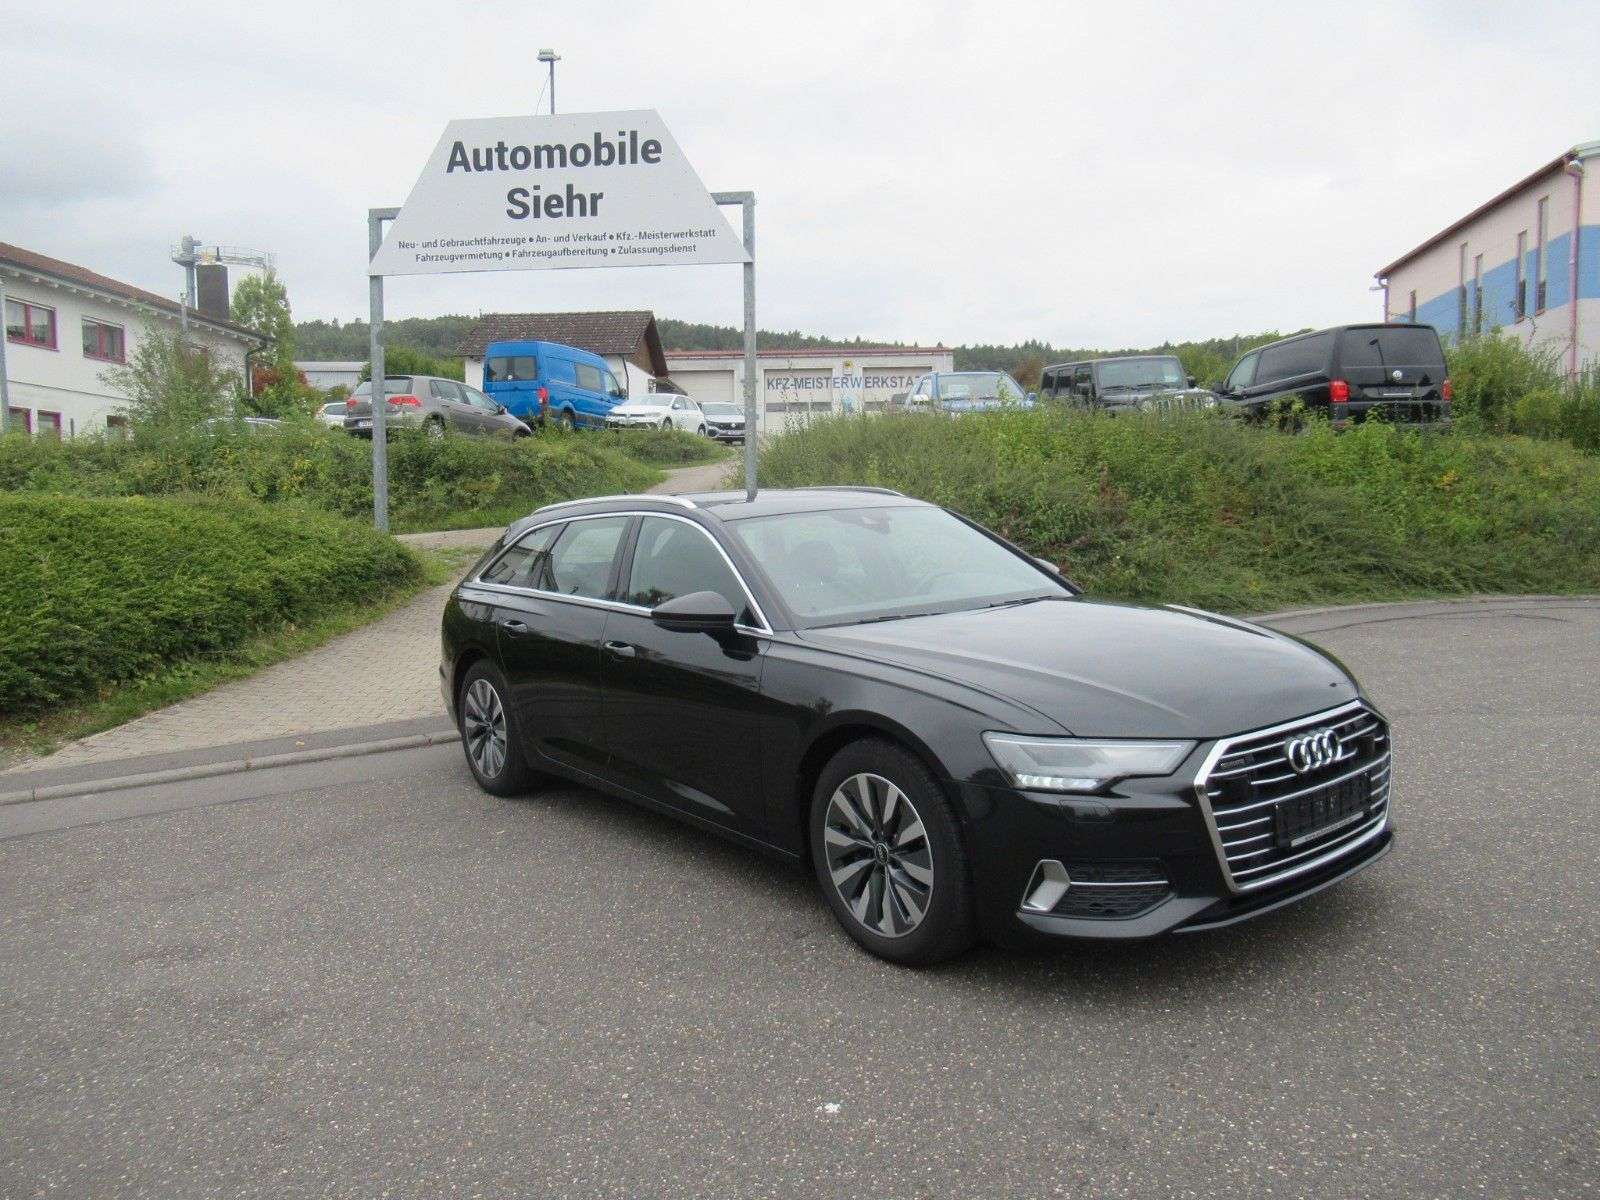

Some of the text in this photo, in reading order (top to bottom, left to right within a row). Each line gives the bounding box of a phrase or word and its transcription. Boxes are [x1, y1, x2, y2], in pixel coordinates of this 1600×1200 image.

[446, 130, 663, 174] Automobile
[506, 183, 604, 220] Siehr
[398, 229, 716, 249] Neu- und Gebrauchtfahrzeuge An- und Verkauf Kfz.-Meisterwerkstatt
[415, 244, 697, 263] Fahrzeugvermietung Fahrzeugaufbereitung Zulassungsdienst
[767, 375, 920, 390] KFZ-MEISTERWERKSTA
